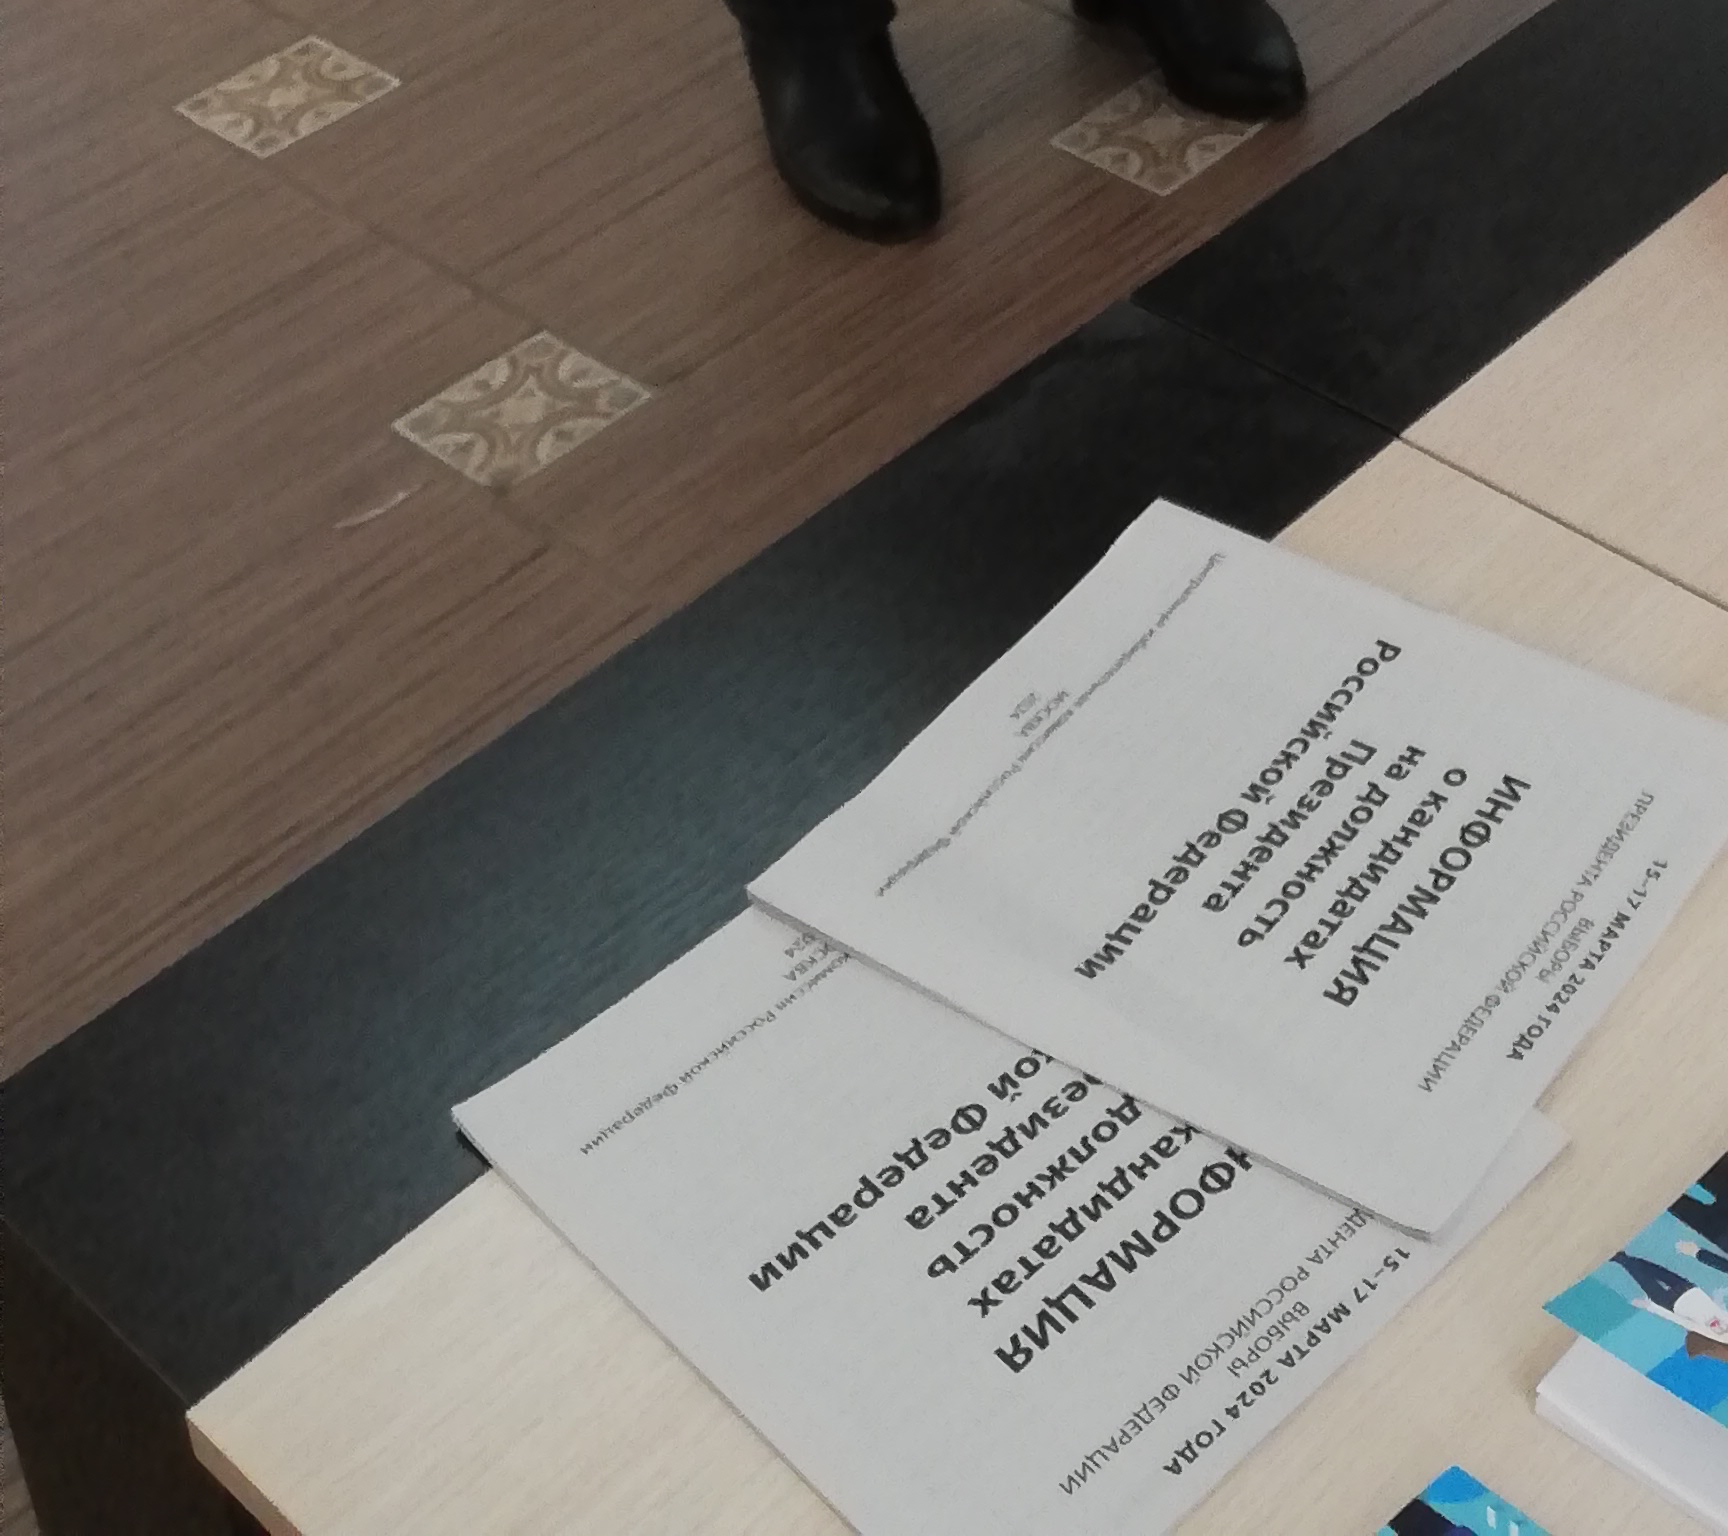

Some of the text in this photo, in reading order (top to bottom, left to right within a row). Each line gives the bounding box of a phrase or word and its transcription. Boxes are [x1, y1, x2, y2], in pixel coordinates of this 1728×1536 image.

[1074, 639, 1402, 980] Российской Федерации
[1201, 739, 1378, 913] Президента
[1236, 744, 1427, 948] на должность
[1283, 767, 1469, 970] о кандидатах
[1322, 773, 1532, 1008] ИНФОРМАЦИЯ
[1417, 791, 1656, 1093] ПРЕЗИДЕНТА РОССИЙСКОЙ ФЕДЕРАЦИИ
[1536, 916, 1596, 985] ВЫБОРЫ
[1544, 972, 1586, 1015] 2024
[1578, 909, 1632, 972] МАРТА
[1505, 1013, 1554, 1061] ГОДА
[747, 1102, 988, 1293] Федерации
[926, 1093, 1144, 1279] должность
[1178, 1265, 1311, 1387] РОССИЙСКОЙ
[1226, 1301, 1311, 1378] ВЫБОРЫ
[1276, 1302, 1352, 1369] МАРТА
[1058, 1383, 1182, 1496] ФЕДЕРАЦИИ
[1162, 1419, 1228, 1476] ГОДА
[1224, 1368, 1280, 1421] 2024
